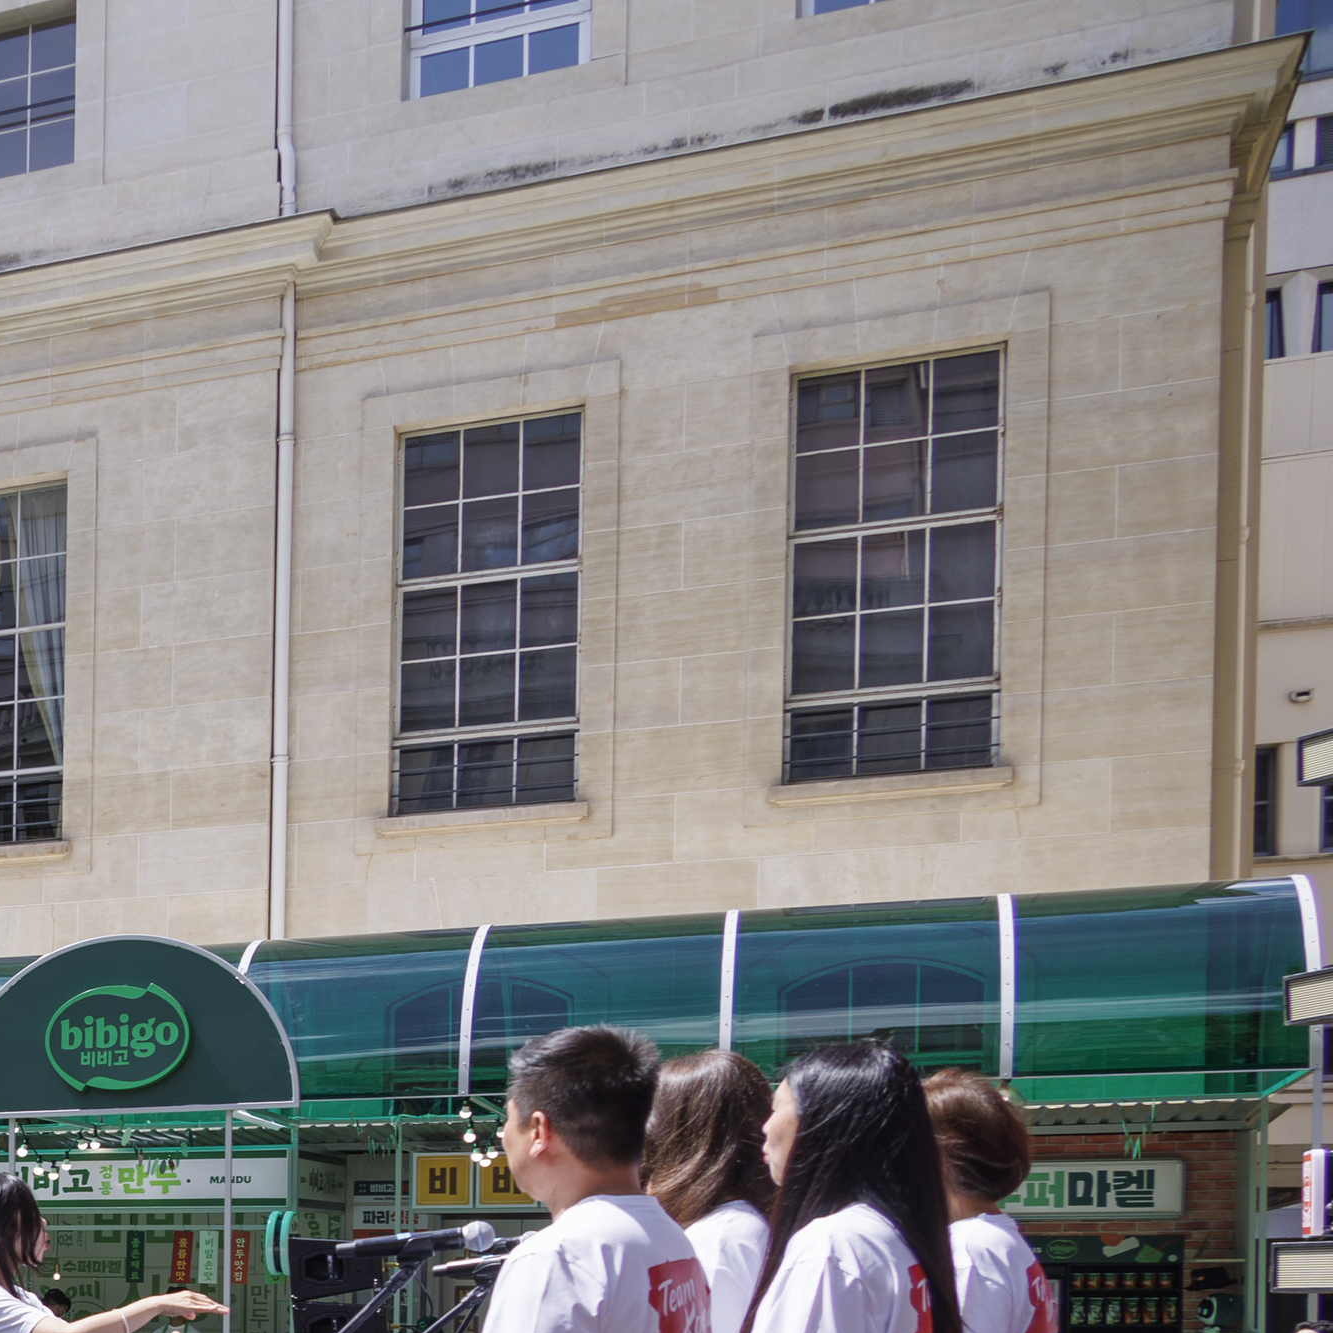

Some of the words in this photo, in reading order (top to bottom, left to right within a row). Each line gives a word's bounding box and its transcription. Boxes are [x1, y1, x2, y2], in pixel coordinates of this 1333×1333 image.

[60, 1013, 180, 1058] bibigo
[80, 1050, 130, 1068] 비비고
[118, 1164, 181, 1195] 만두
[233, 1237, 246, 1281] 만두맛집
[657, 1278, 696, 1316] Team
